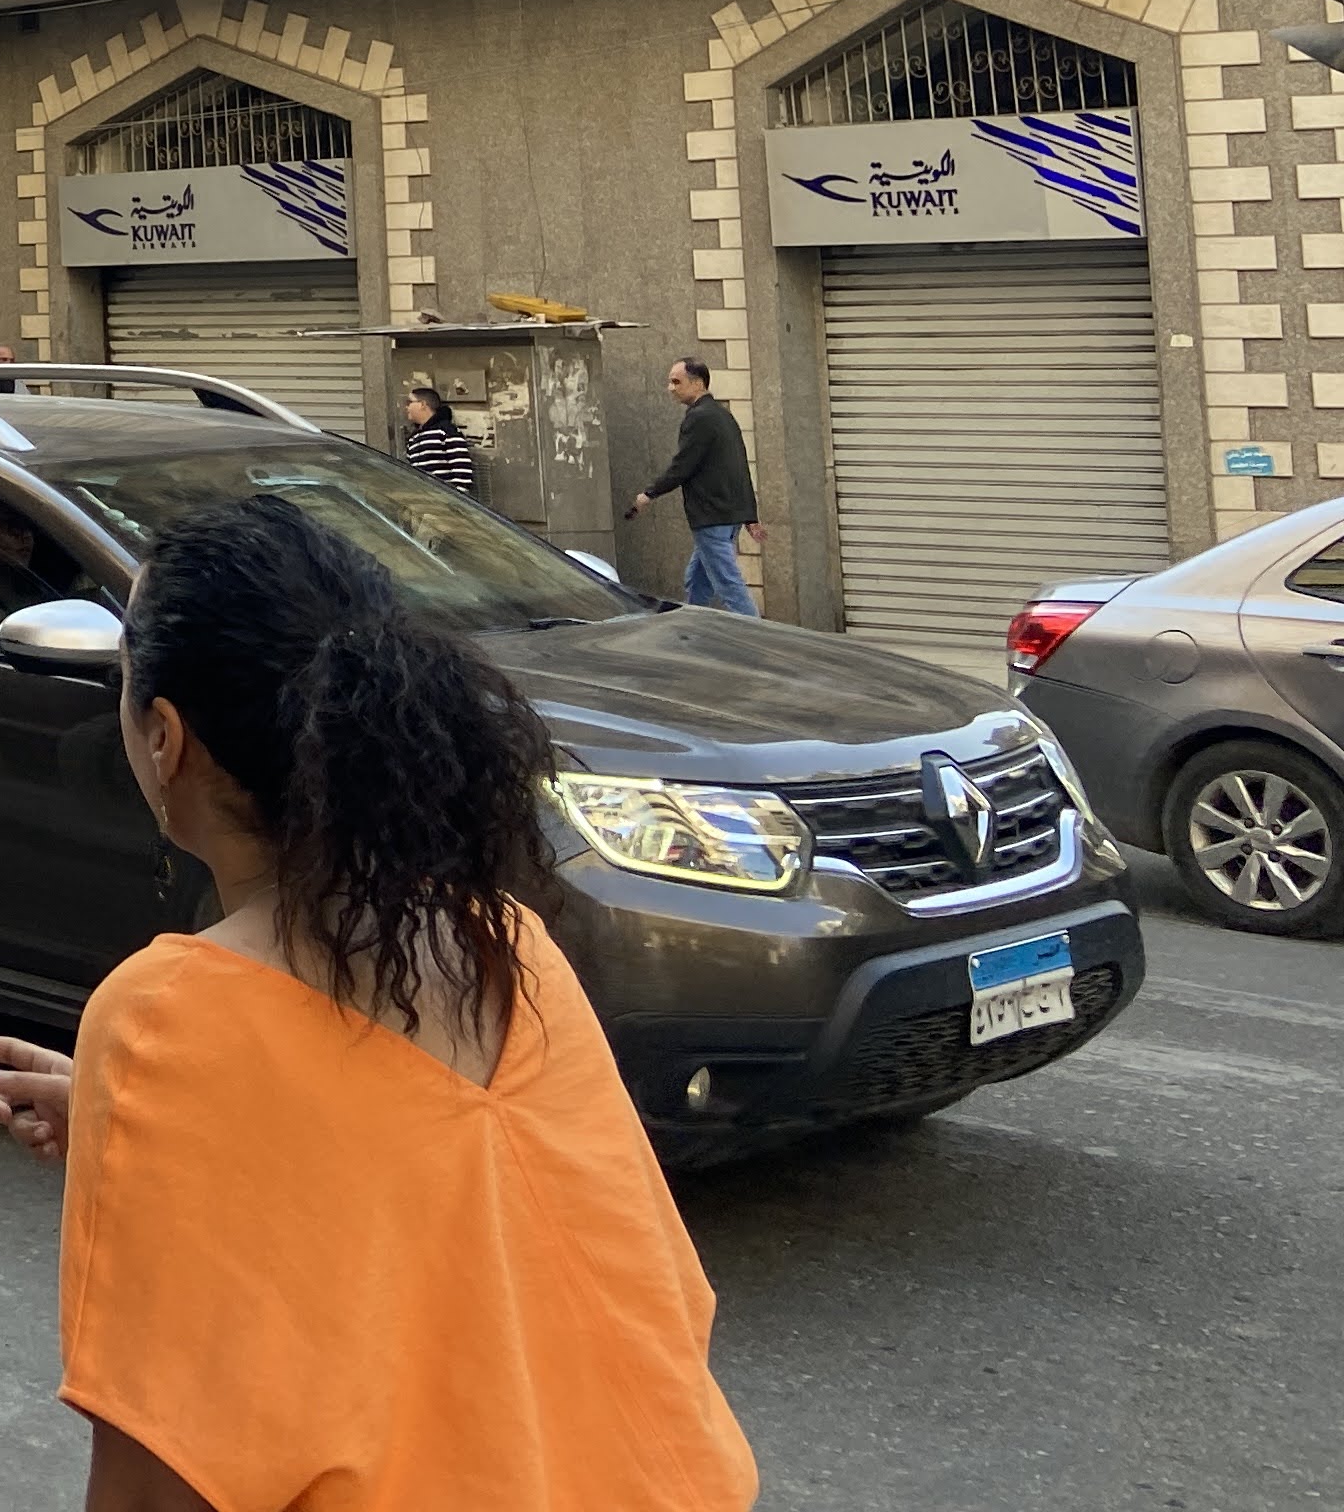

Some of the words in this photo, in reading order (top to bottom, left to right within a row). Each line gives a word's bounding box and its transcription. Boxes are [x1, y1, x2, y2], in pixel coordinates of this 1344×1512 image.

[869, 148, 955, 186] الكويتية
[869, 189, 958, 209] KUWAIT
[131, 224, 195, 242] KUWAIT
